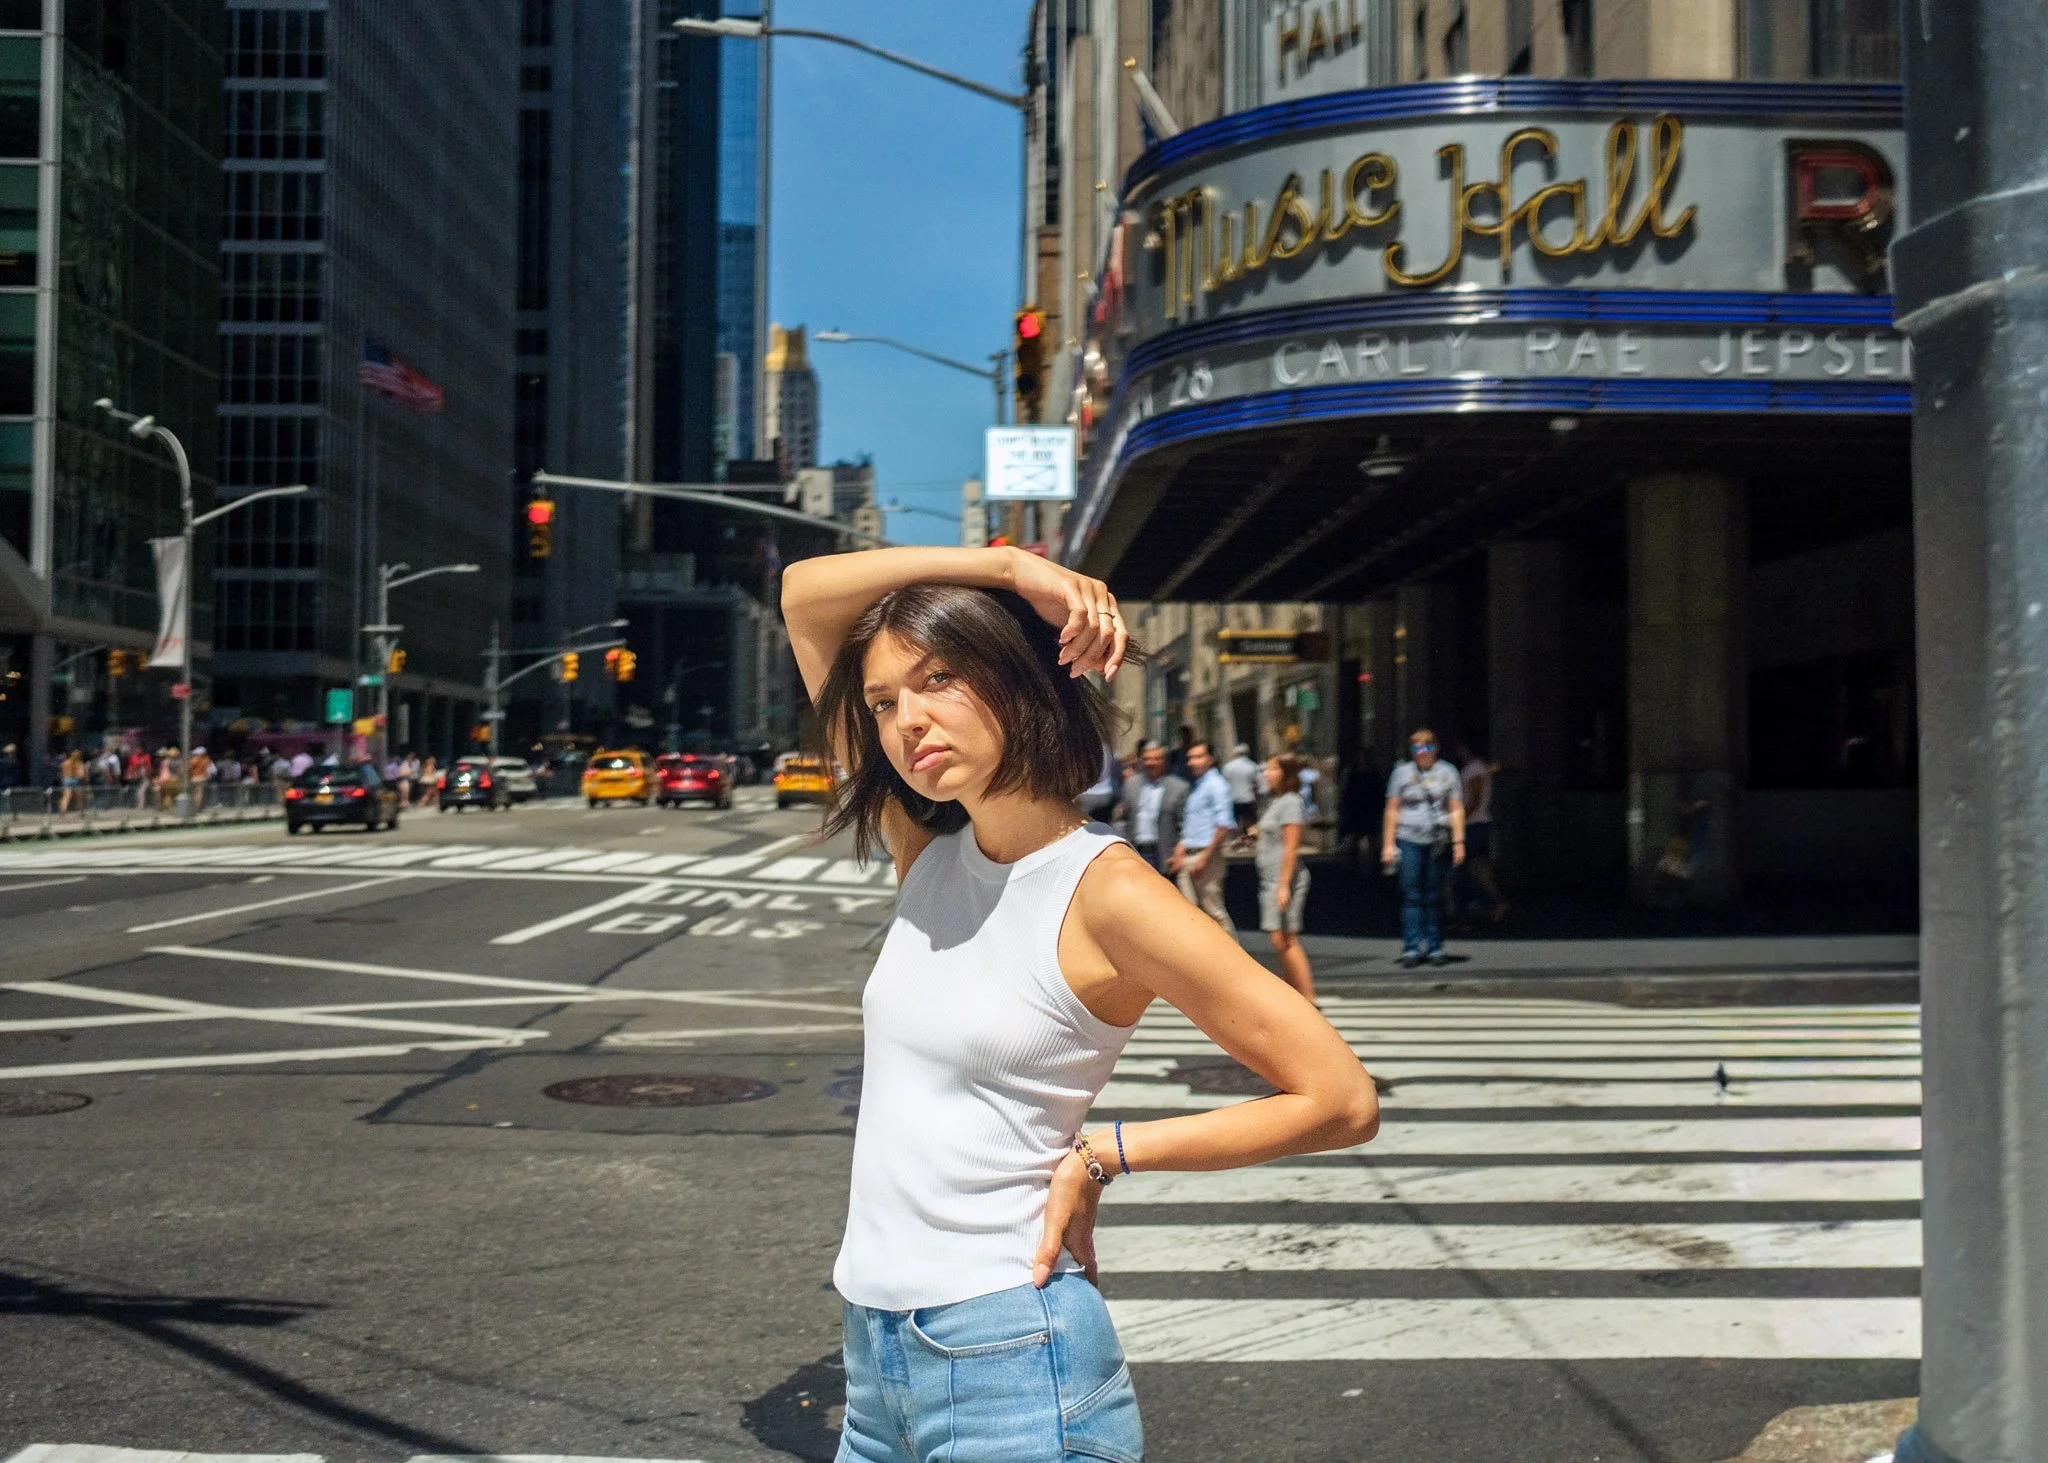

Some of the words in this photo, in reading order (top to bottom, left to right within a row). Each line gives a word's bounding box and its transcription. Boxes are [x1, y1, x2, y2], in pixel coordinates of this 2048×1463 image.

[1150, 153, 1400, 319] Music
[1383, 116, 1697, 286] Hall
[1273, 331, 1468, 384] CARLY
[1525, 329, 1644, 373] RAE
[636, 888, 886, 914] ONLY
[587, 914, 826, 940] BUS
